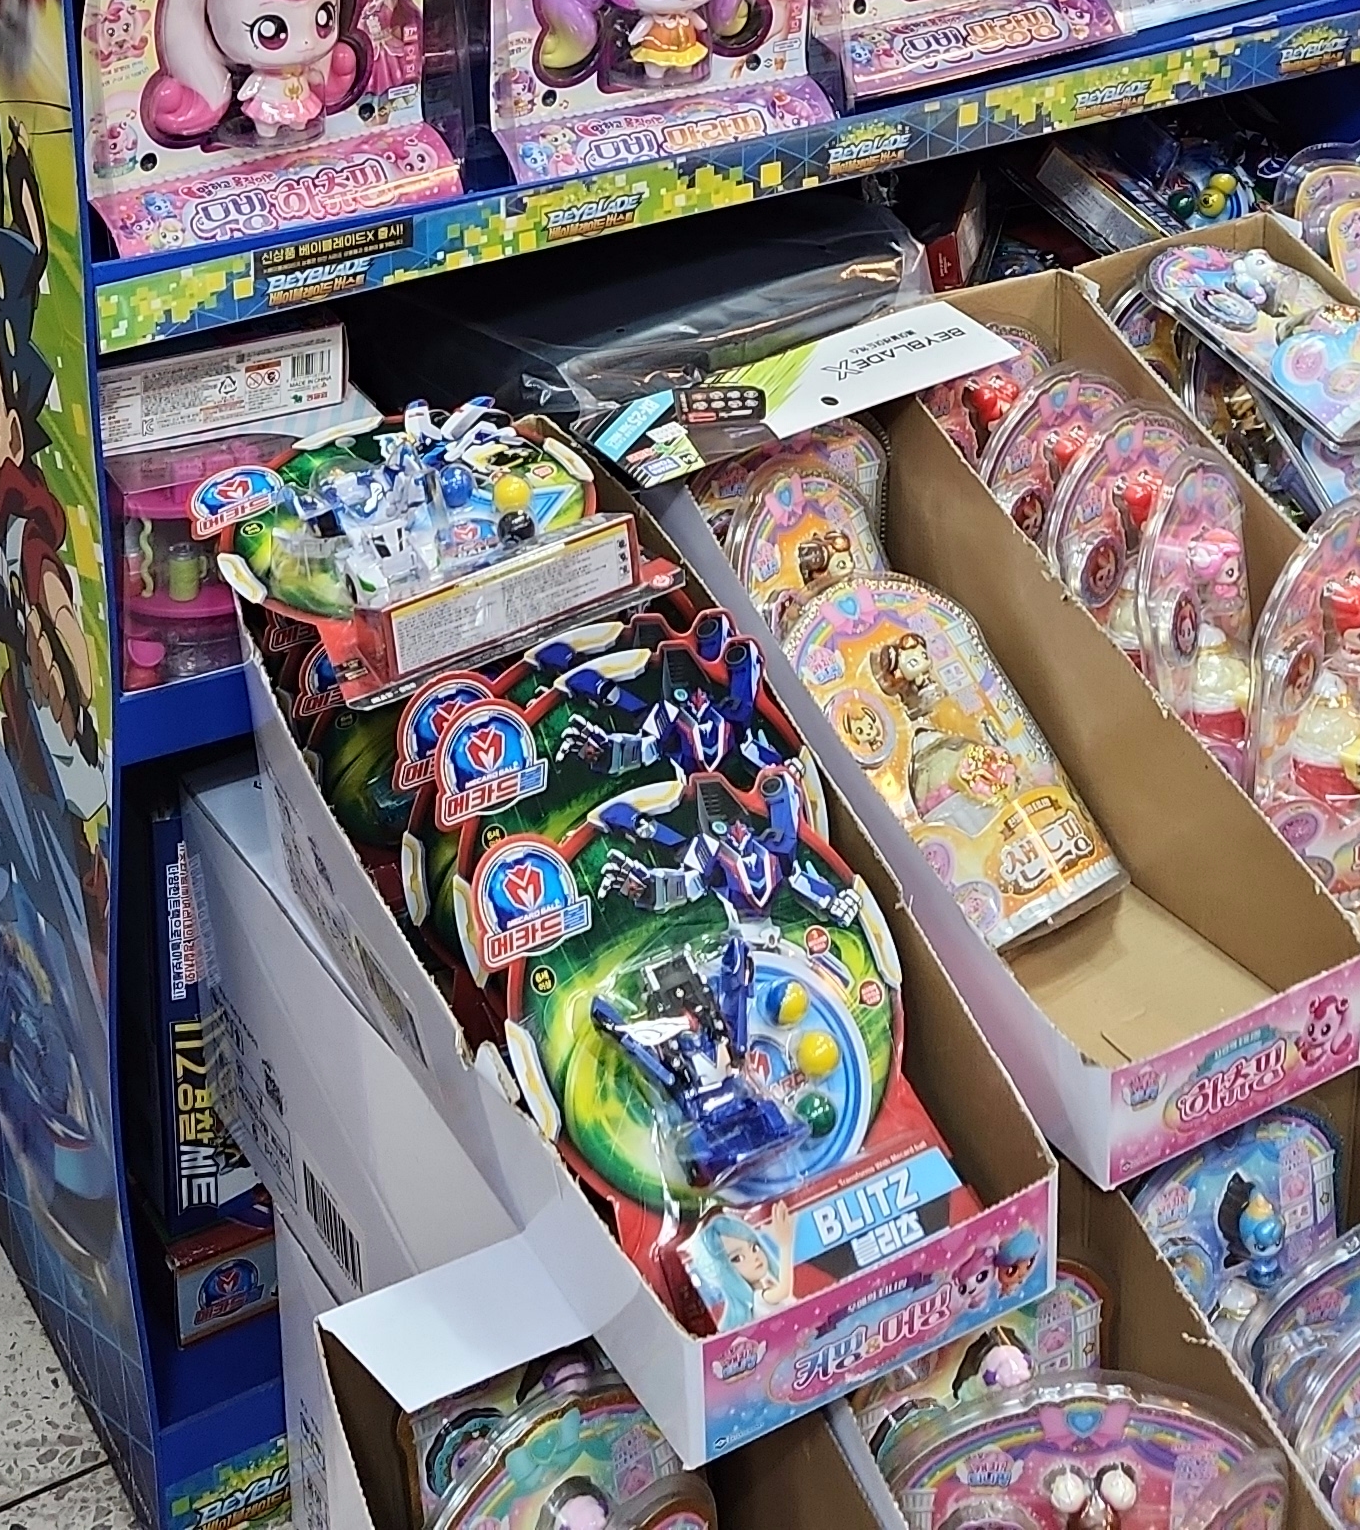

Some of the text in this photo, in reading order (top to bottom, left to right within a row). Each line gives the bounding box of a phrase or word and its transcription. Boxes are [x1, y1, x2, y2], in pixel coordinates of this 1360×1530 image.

[1074, 81, 1153, 110] BEYBLADE
[830, 132, 911, 163] BEYBLADE
[199, 188, 276, 239] 무빙
[548, 193, 643, 227] BEYBLADE
[261, 246, 295, 264] 신상품
[447, 778, 520, 821] 메카드
[507, 900, 561, 927] MECARD BALL
[489, 913, 564, 961] 메카드
[812, 1167, 920, 1247] BLITZ
